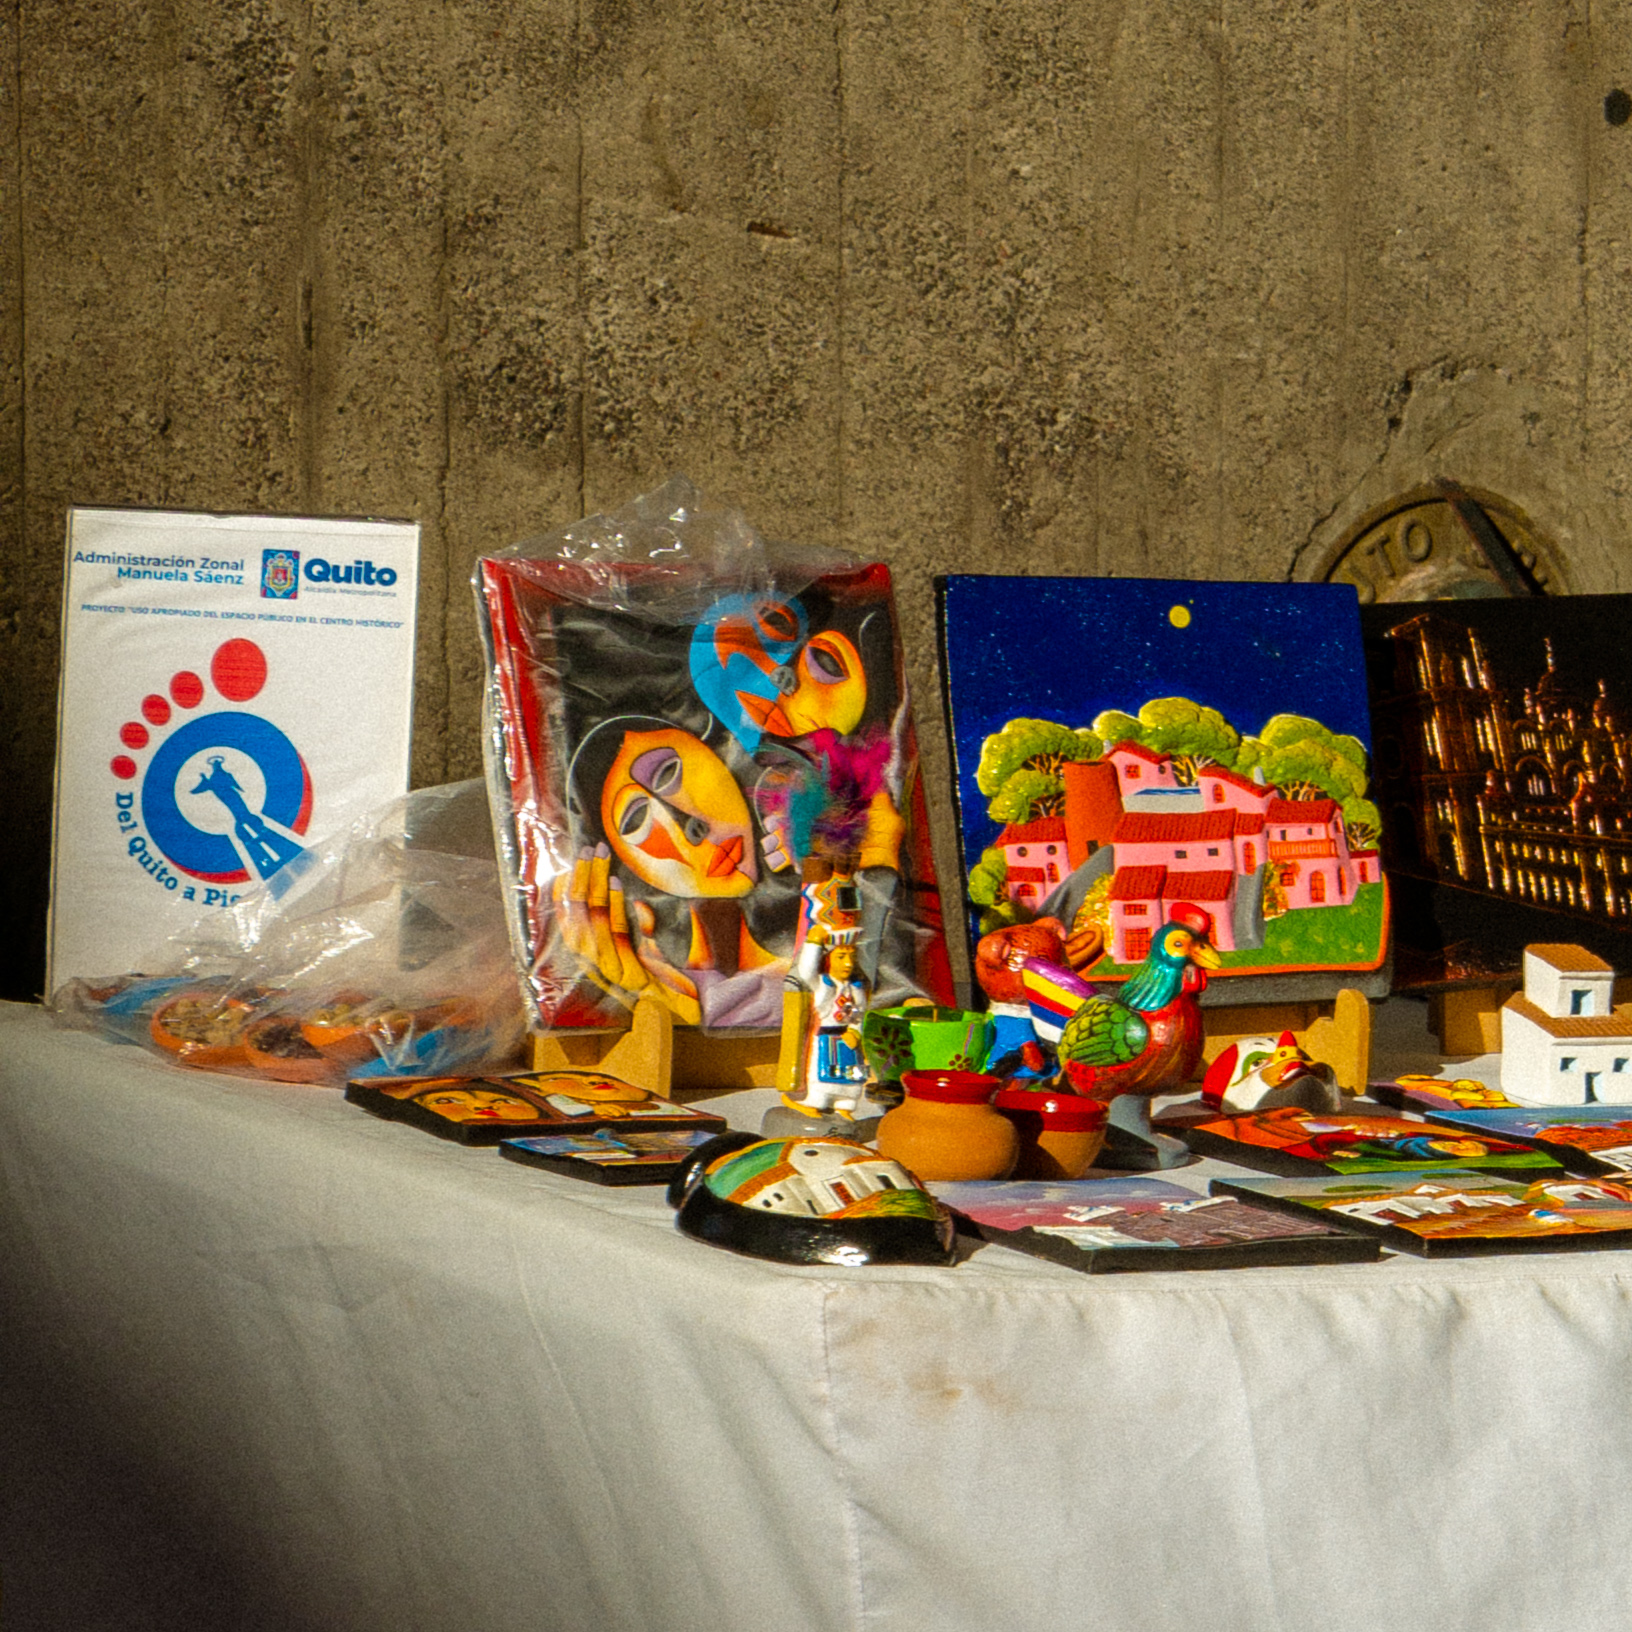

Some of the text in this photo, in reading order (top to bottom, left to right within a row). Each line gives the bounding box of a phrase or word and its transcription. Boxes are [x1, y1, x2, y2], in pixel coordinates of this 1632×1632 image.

[73, 551, 244, 570] Administración Zonal
[117, 567, 244, 585] Manuela Sáenz
[303, 558, 398, 586] Quito
[151, 607, 201, 617] APROPIADO
[203, 610, 218, 618] DEL
[221, 611, 256, 621] ESPACIO
[320, 618, 353, 626] CENTRO
[116, 791, 138, 834] Del
[128, 836, 178, 890] Quito
[183, 885, 196, 901] a
